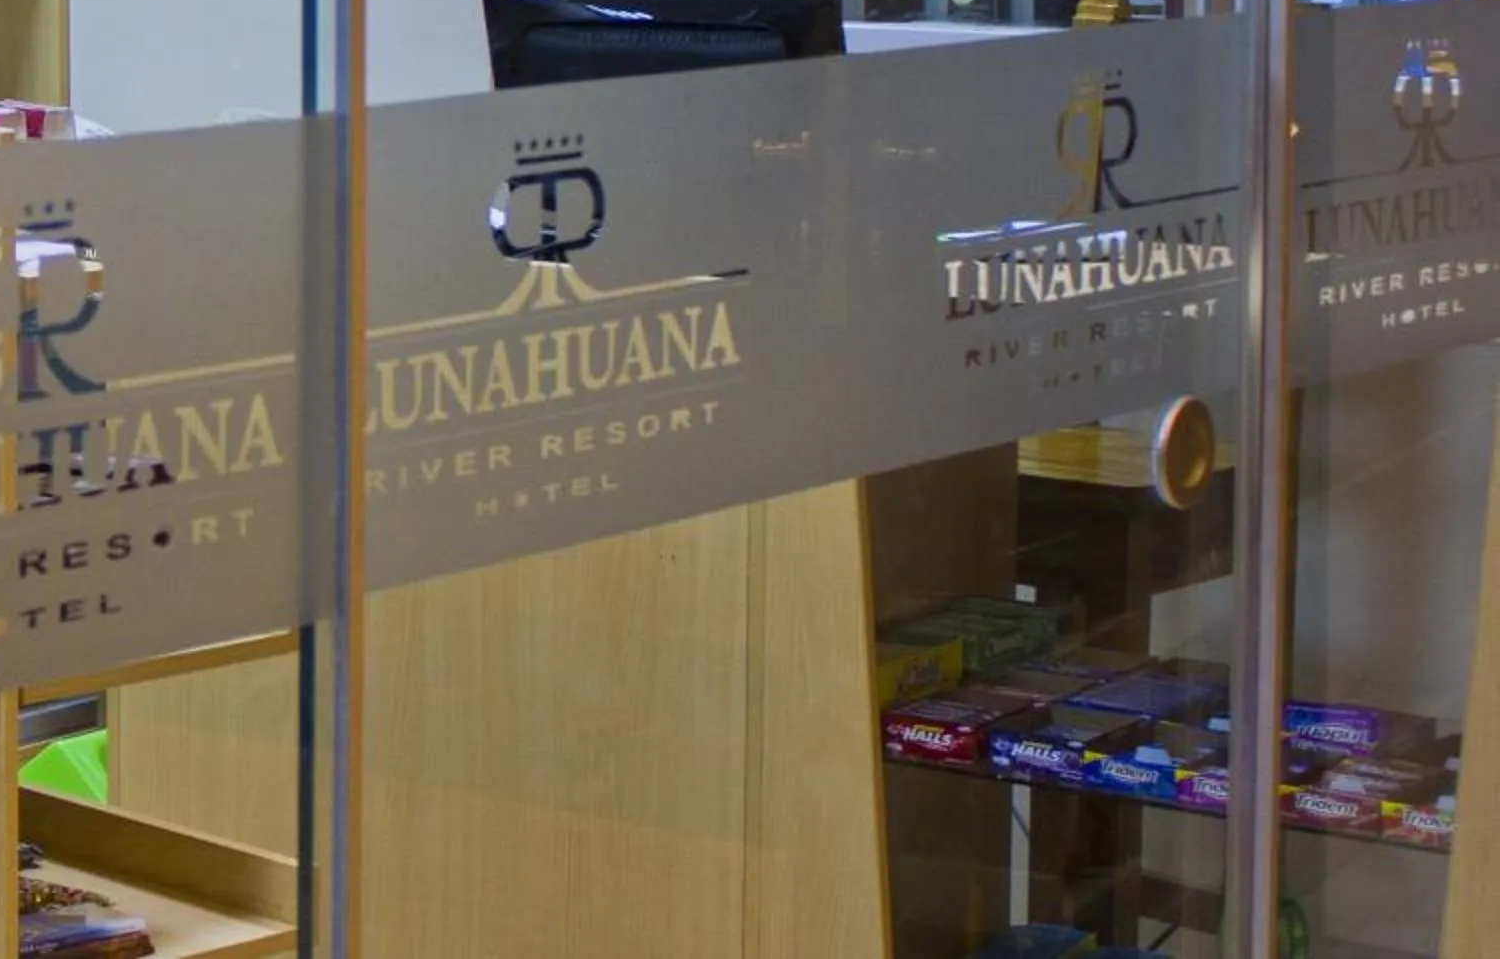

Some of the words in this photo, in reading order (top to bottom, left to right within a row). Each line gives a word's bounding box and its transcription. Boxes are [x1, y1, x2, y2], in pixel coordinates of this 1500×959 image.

[944, 213, 1236, 321] LUNAHUANA
[1318, 273, 1405, 306] RIVER
[364, 445, 513, 495] RIVER
[539, 401, 721, 461] RESORT
[902, 725, 953, 747] HALLS
[1011, 743, 1062, 763] HALLS
[1101, 759, 1160, 783] Trident
[1295, 792, 1359, 817] Trident
